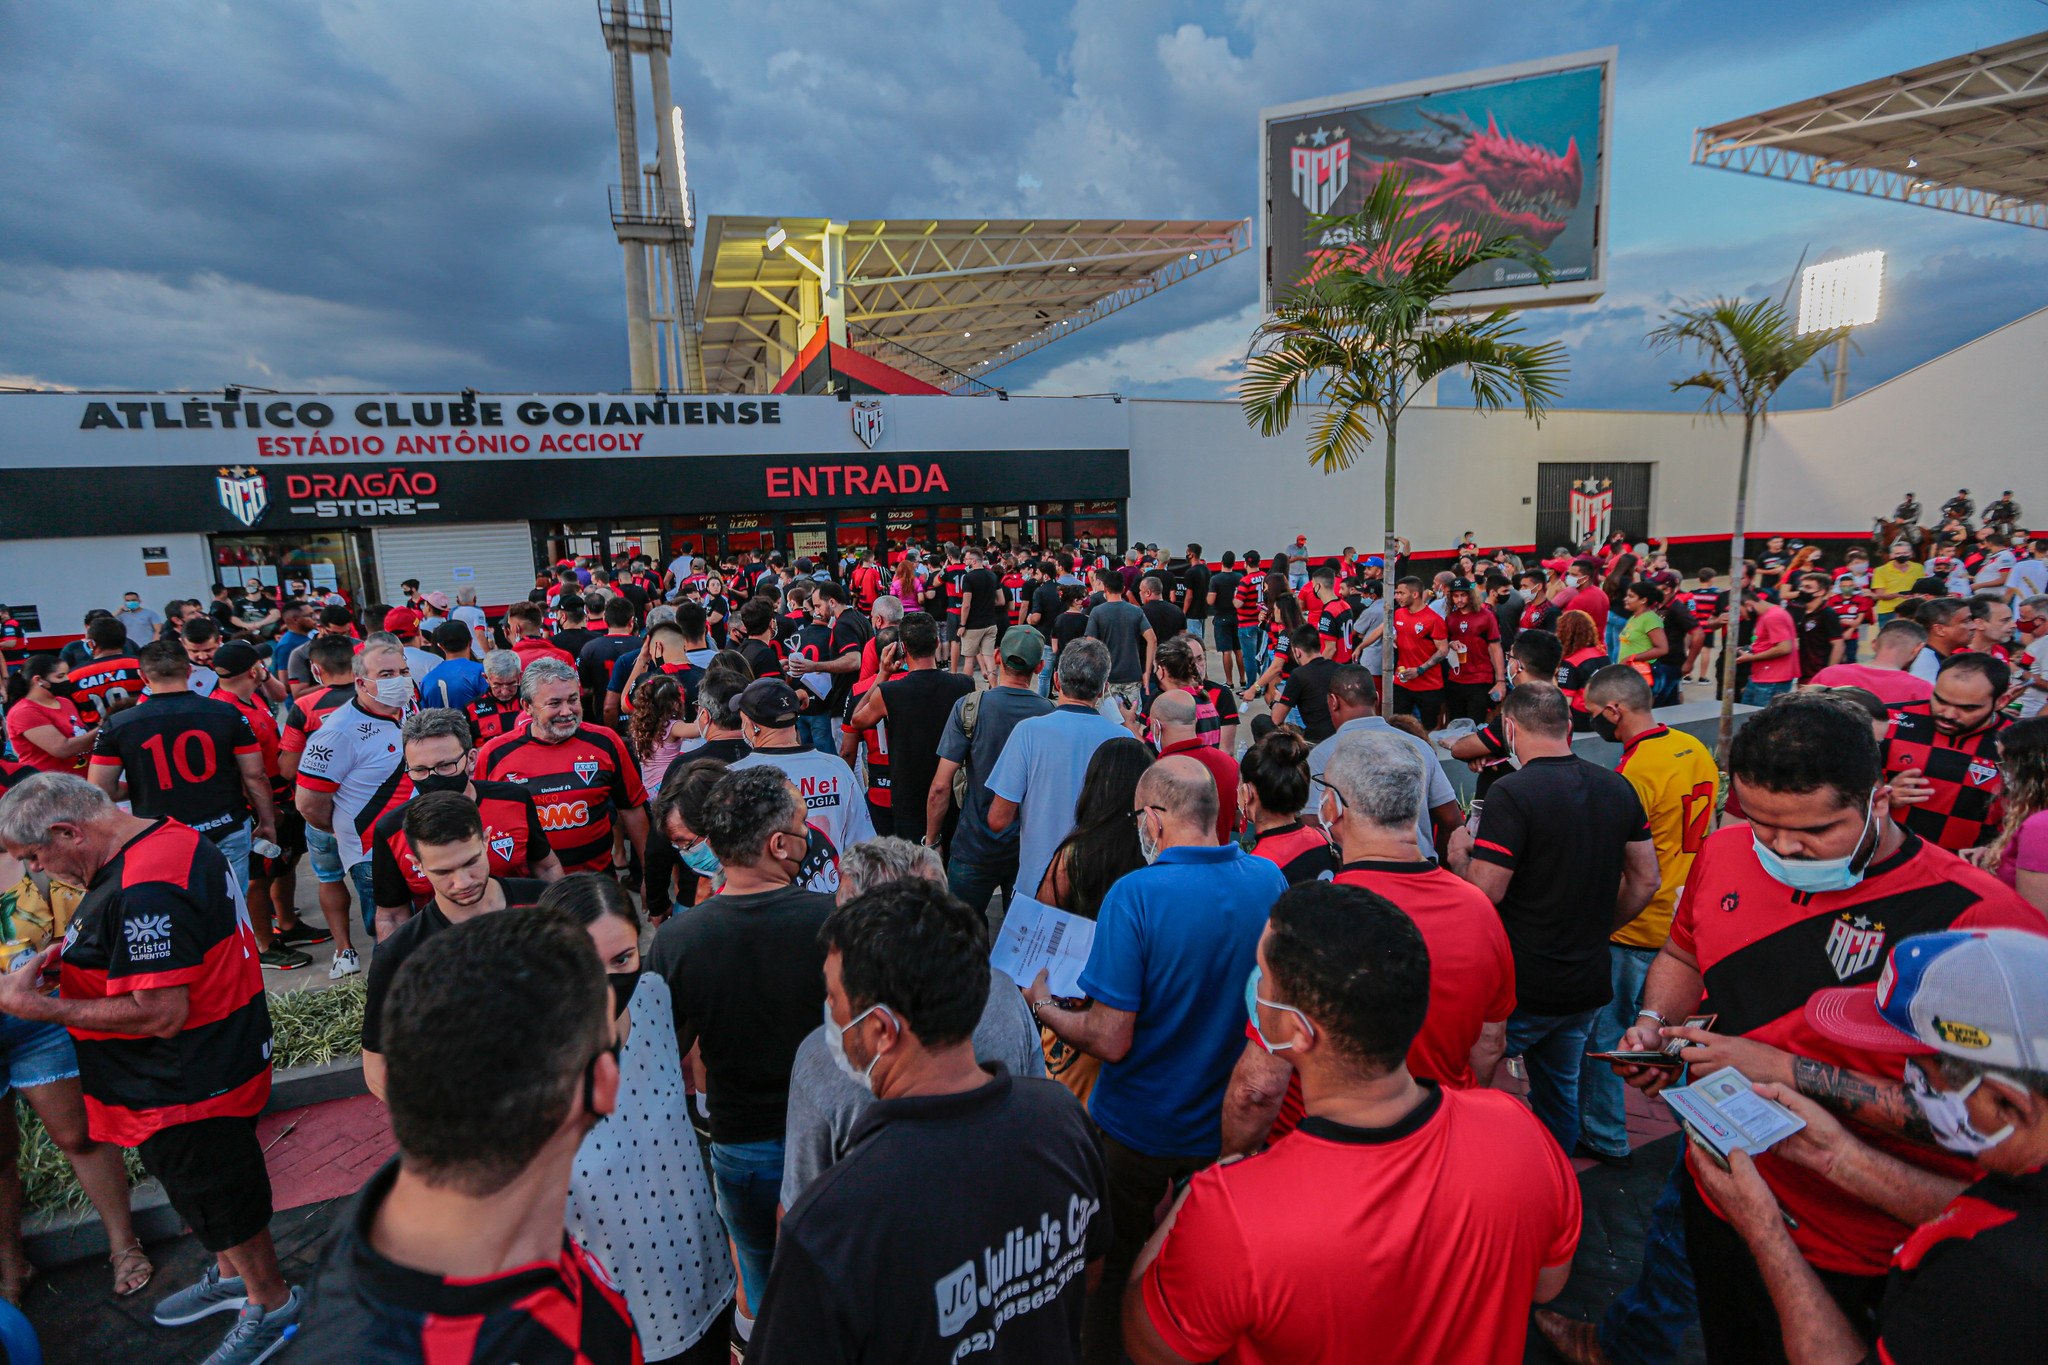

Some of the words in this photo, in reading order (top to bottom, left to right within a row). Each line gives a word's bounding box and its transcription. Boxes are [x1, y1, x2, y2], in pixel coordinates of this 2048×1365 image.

[80, 396, 334, 429] ATLÉTICO
[355, 401, 504, 428] CLUBE
[517, 401, 781, 426] GOIANIENSE
[257, 430, 385, 456] ESTÁDIO
[396, 430, 530, 455] ANTÔNIO
[539, 433, 644, 453] ACCIOLY
[286, 468, 438, 499] DRAGÃO
[766, 463, 950, 498] ENTRADA
[315, 498, 417, 518] STORE
[79, 669, 128, 689] CAIXA
[141, 729, 217, 790] 10
[303, 758, 329, 770] Cristal
[536, 800, 589, 831] BMG
[129, 939, 171, 954] Cristal
[130, 951, 171, 961] ALIMENTOS
[1825, 918, 1886, 982] ACG
[978, 1212, 1062, 1307] Juliu's
[1033, 1274, 1042, 1288] e
